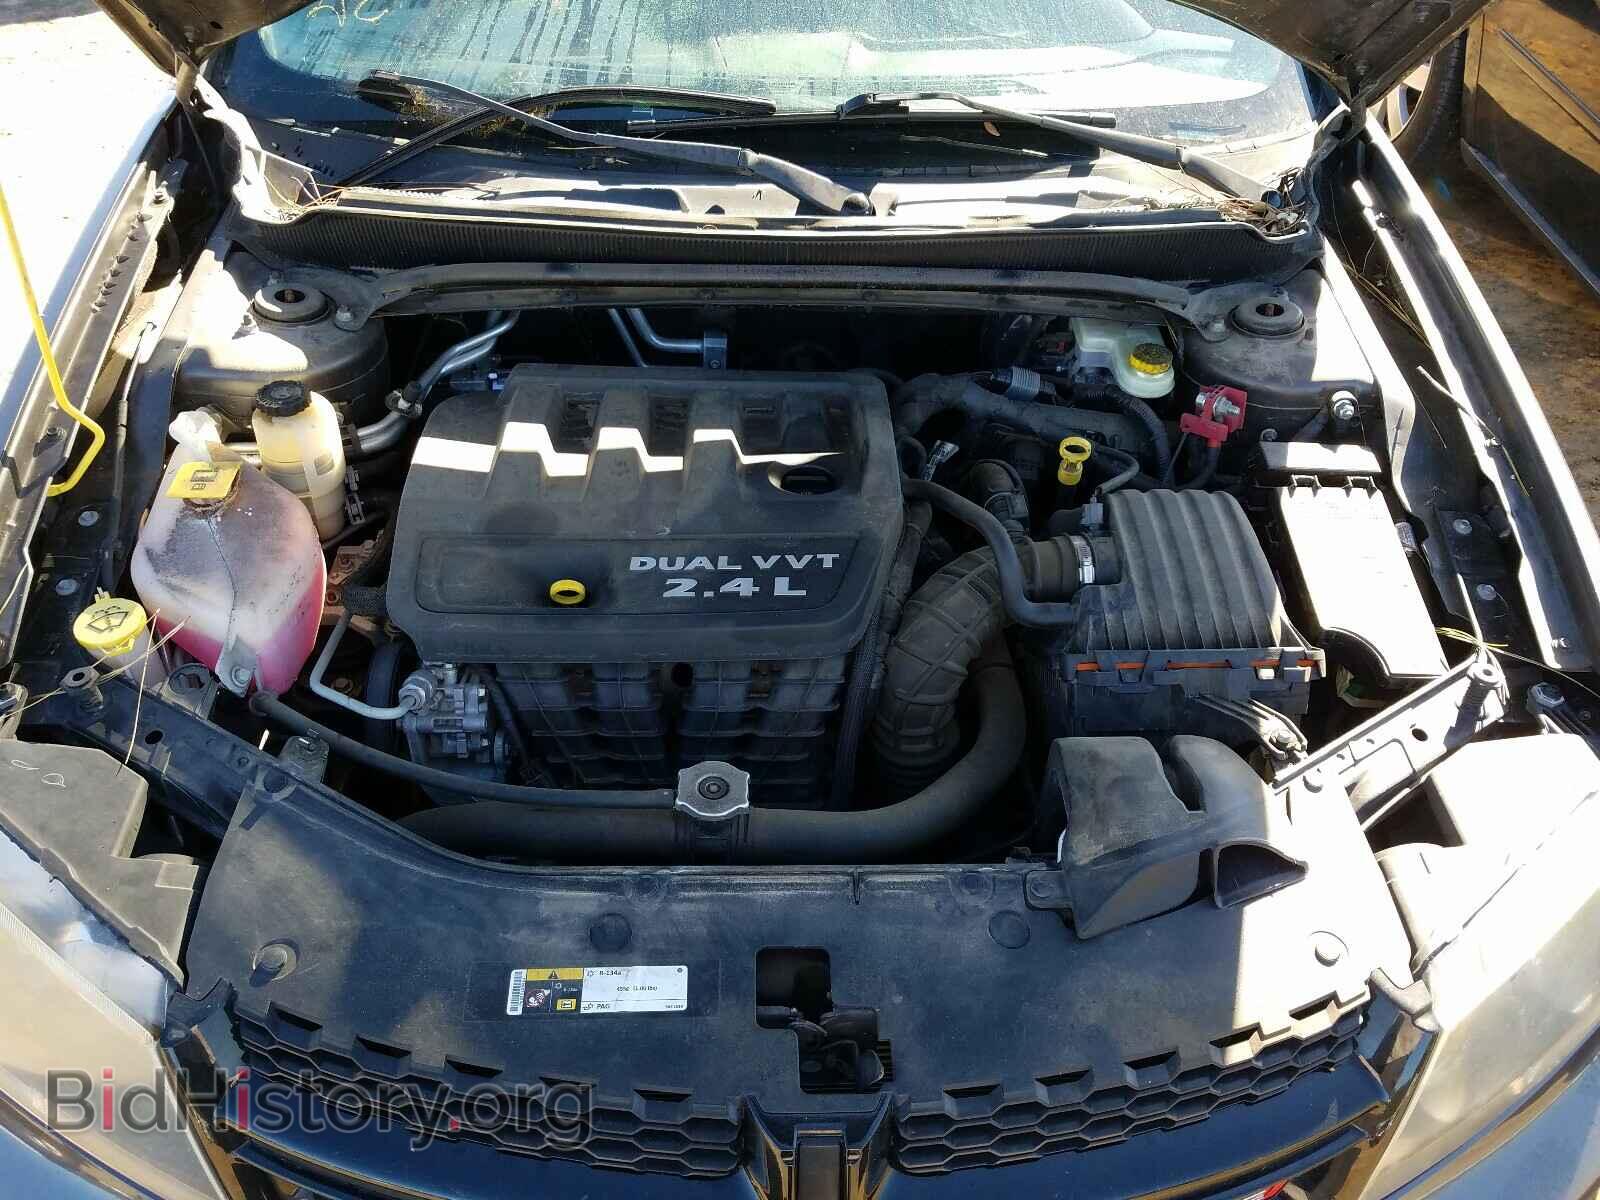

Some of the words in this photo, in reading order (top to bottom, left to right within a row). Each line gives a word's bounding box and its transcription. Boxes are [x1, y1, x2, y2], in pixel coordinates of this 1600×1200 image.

[629, 555, 742, 571] DUAL
[752, 553, 840, 569] VVT
[662, 577, 760, 597] 2.4
[773, 576, 807, 597] L
